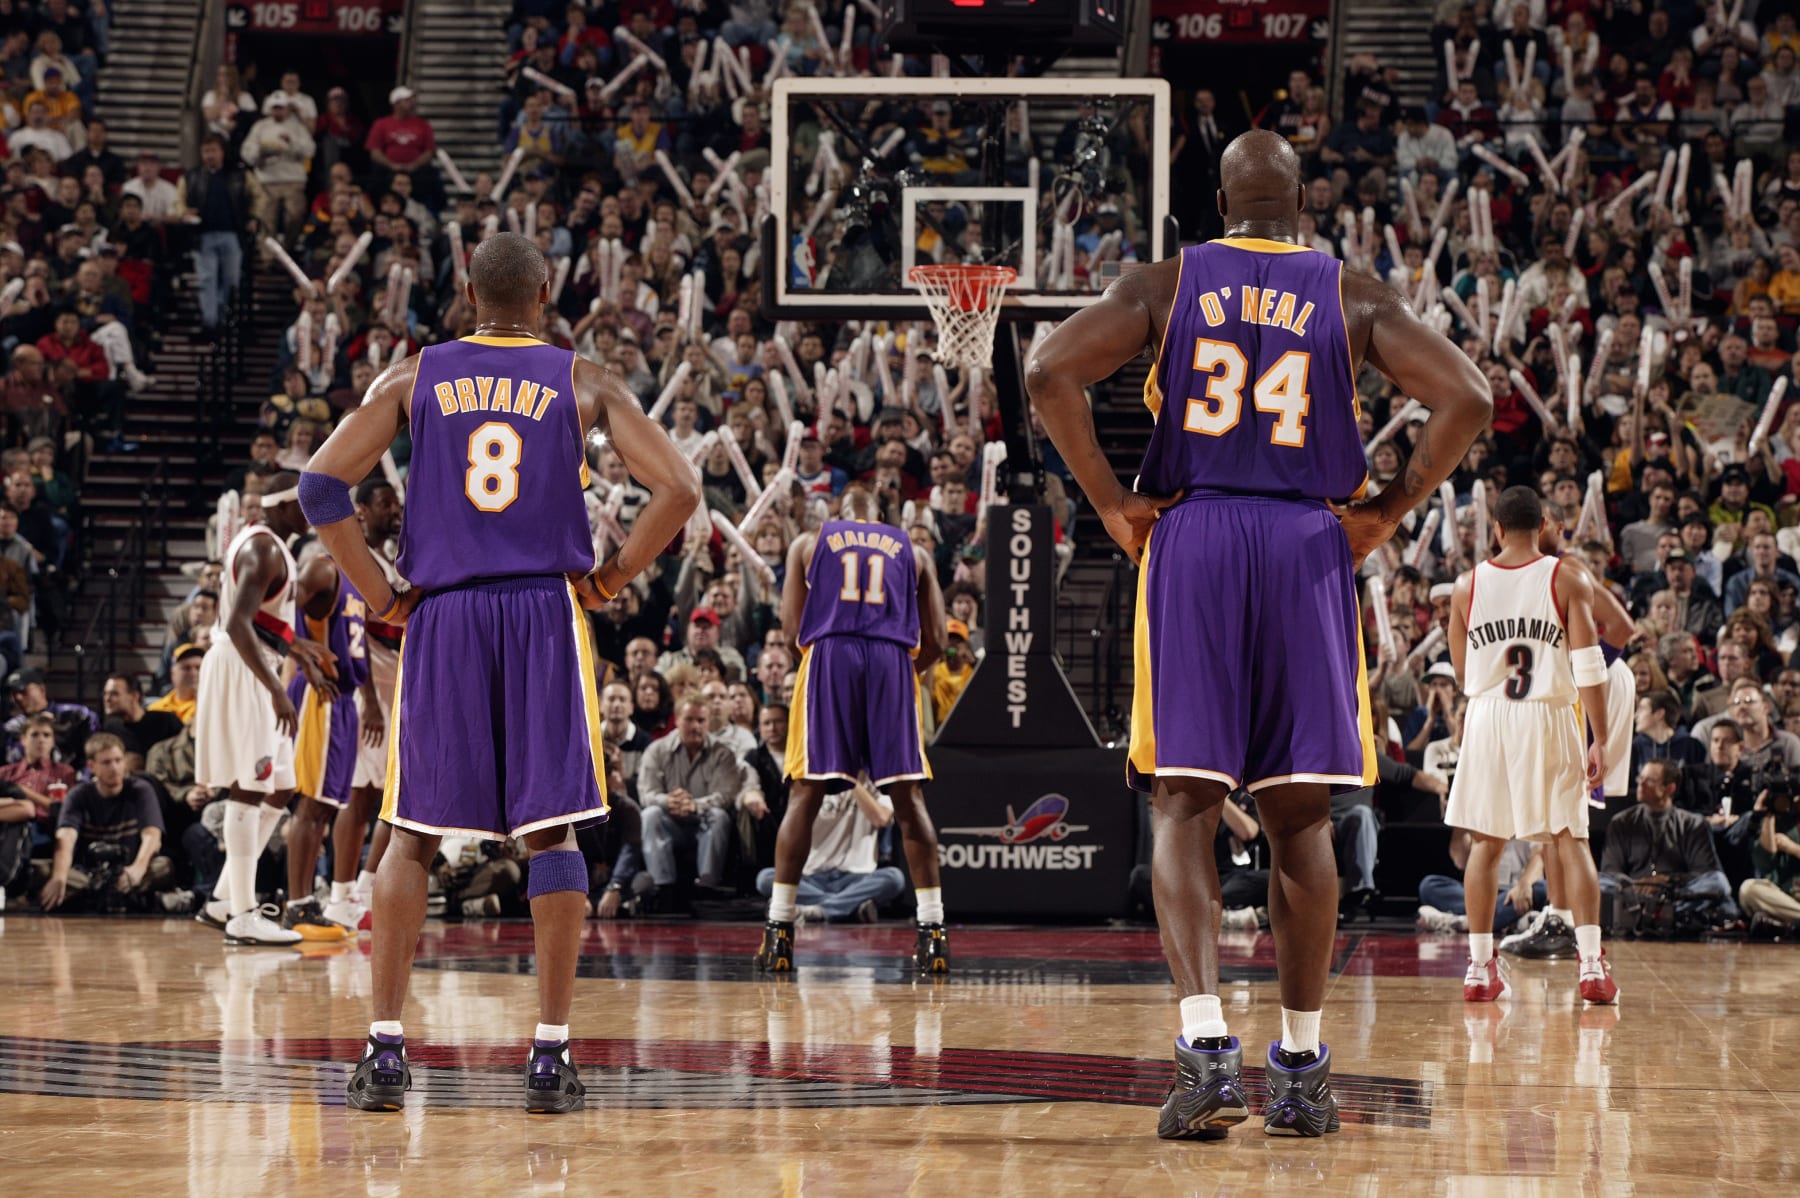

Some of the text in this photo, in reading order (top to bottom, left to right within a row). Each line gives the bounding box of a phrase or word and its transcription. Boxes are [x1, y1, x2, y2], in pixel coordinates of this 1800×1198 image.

[253, 3, 298, 28] 105
[336, 6, 381, 31] 106
[1177, 13, 1222, 38] 106
[1263, 13, 1307, 38] 107
[434, 376, 559, 421] BRYANT
[1183, 337, 1311, 447] 34
[465, 421, 523, 513] 8
[826, 530, 903, 559] MALONE
[840, 551, 885, 605] 11
[1005, 508, 1033, 728] SOUTHWEST
[1467, 617, 1564, 650] STOUDAMIRE
[1505, 644, 1534, 700] 3
[1208, 1062, 1228, 1070] 34
[1284, 1081, 1303, 1089] 34
